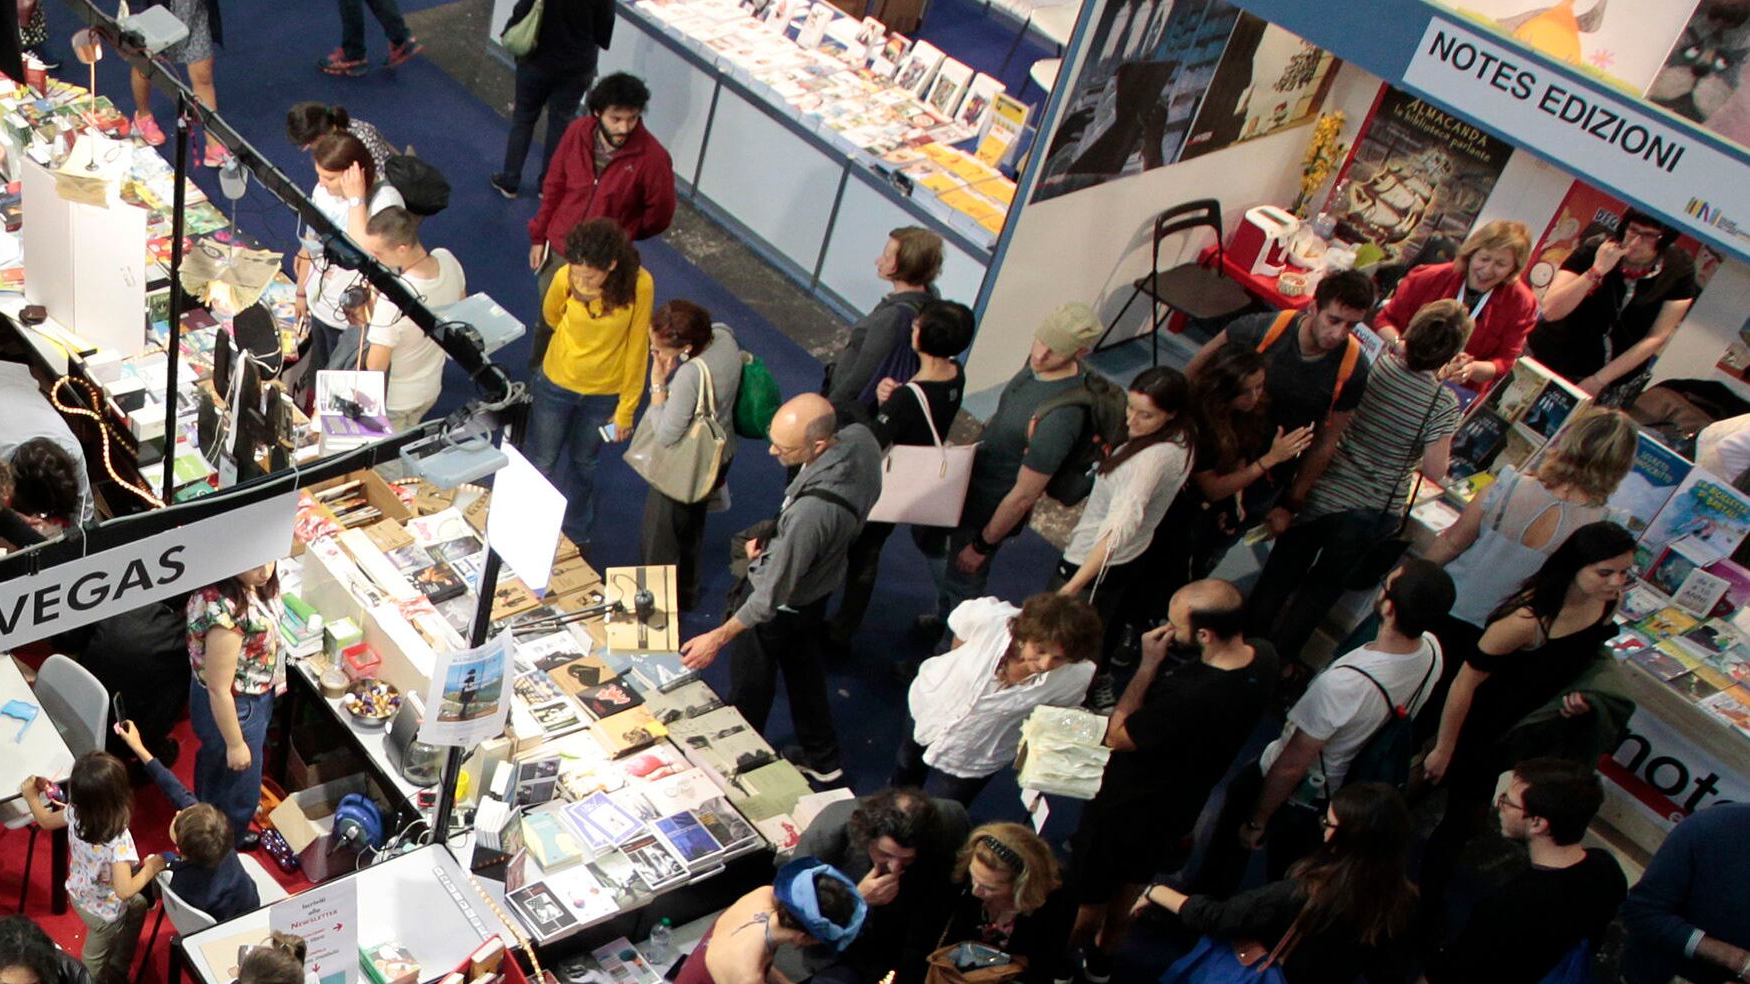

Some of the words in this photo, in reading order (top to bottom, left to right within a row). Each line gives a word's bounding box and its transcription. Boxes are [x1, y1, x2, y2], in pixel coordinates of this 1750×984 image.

[1406, 98, 1488, 147] ALMACANDA
[1428, 31, 1536, 101] NOTES
[1537, 85, 1687, 173] EDIZIONI
[1610, 728, 1736, 816] not
